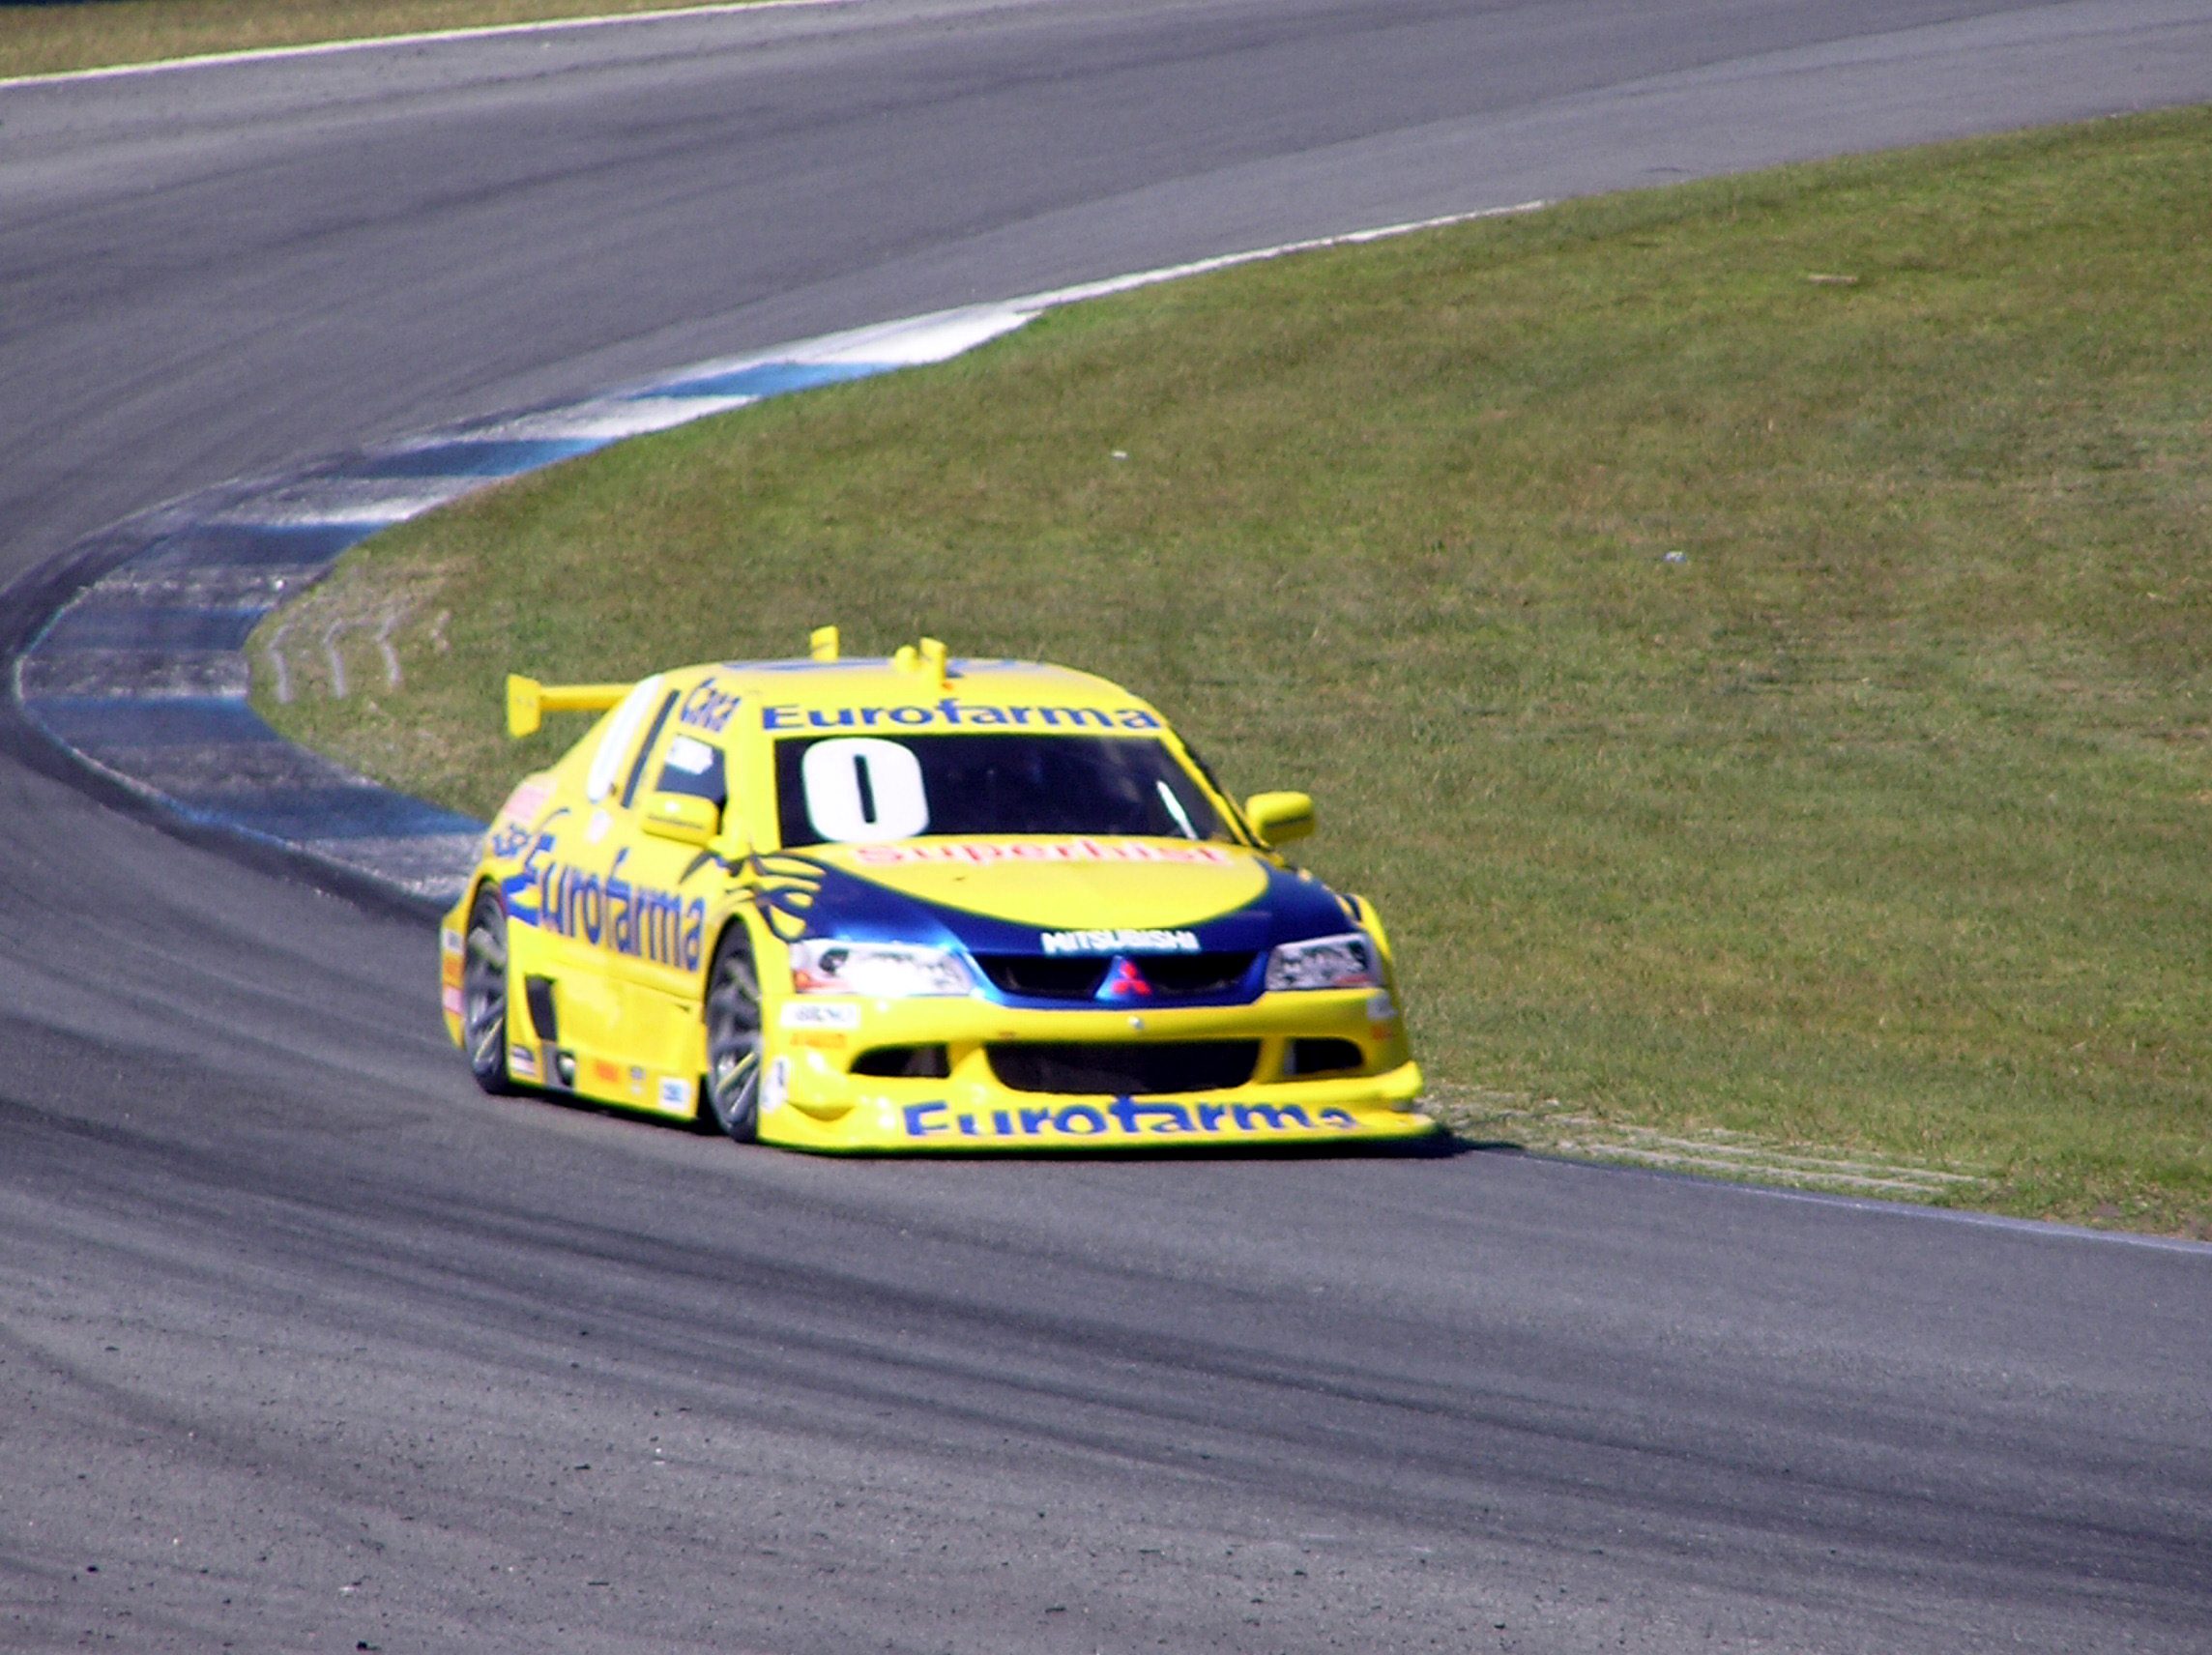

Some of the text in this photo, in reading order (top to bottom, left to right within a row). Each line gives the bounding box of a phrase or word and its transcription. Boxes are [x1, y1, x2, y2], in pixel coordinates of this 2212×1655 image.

[762, 698, 1162, 730] Eurofarma
[802, 737, 929, 844] 0
[502, 833, 706, 972] Eurofarma
[1040, 930, 1201, 955] MITSUBISHI
